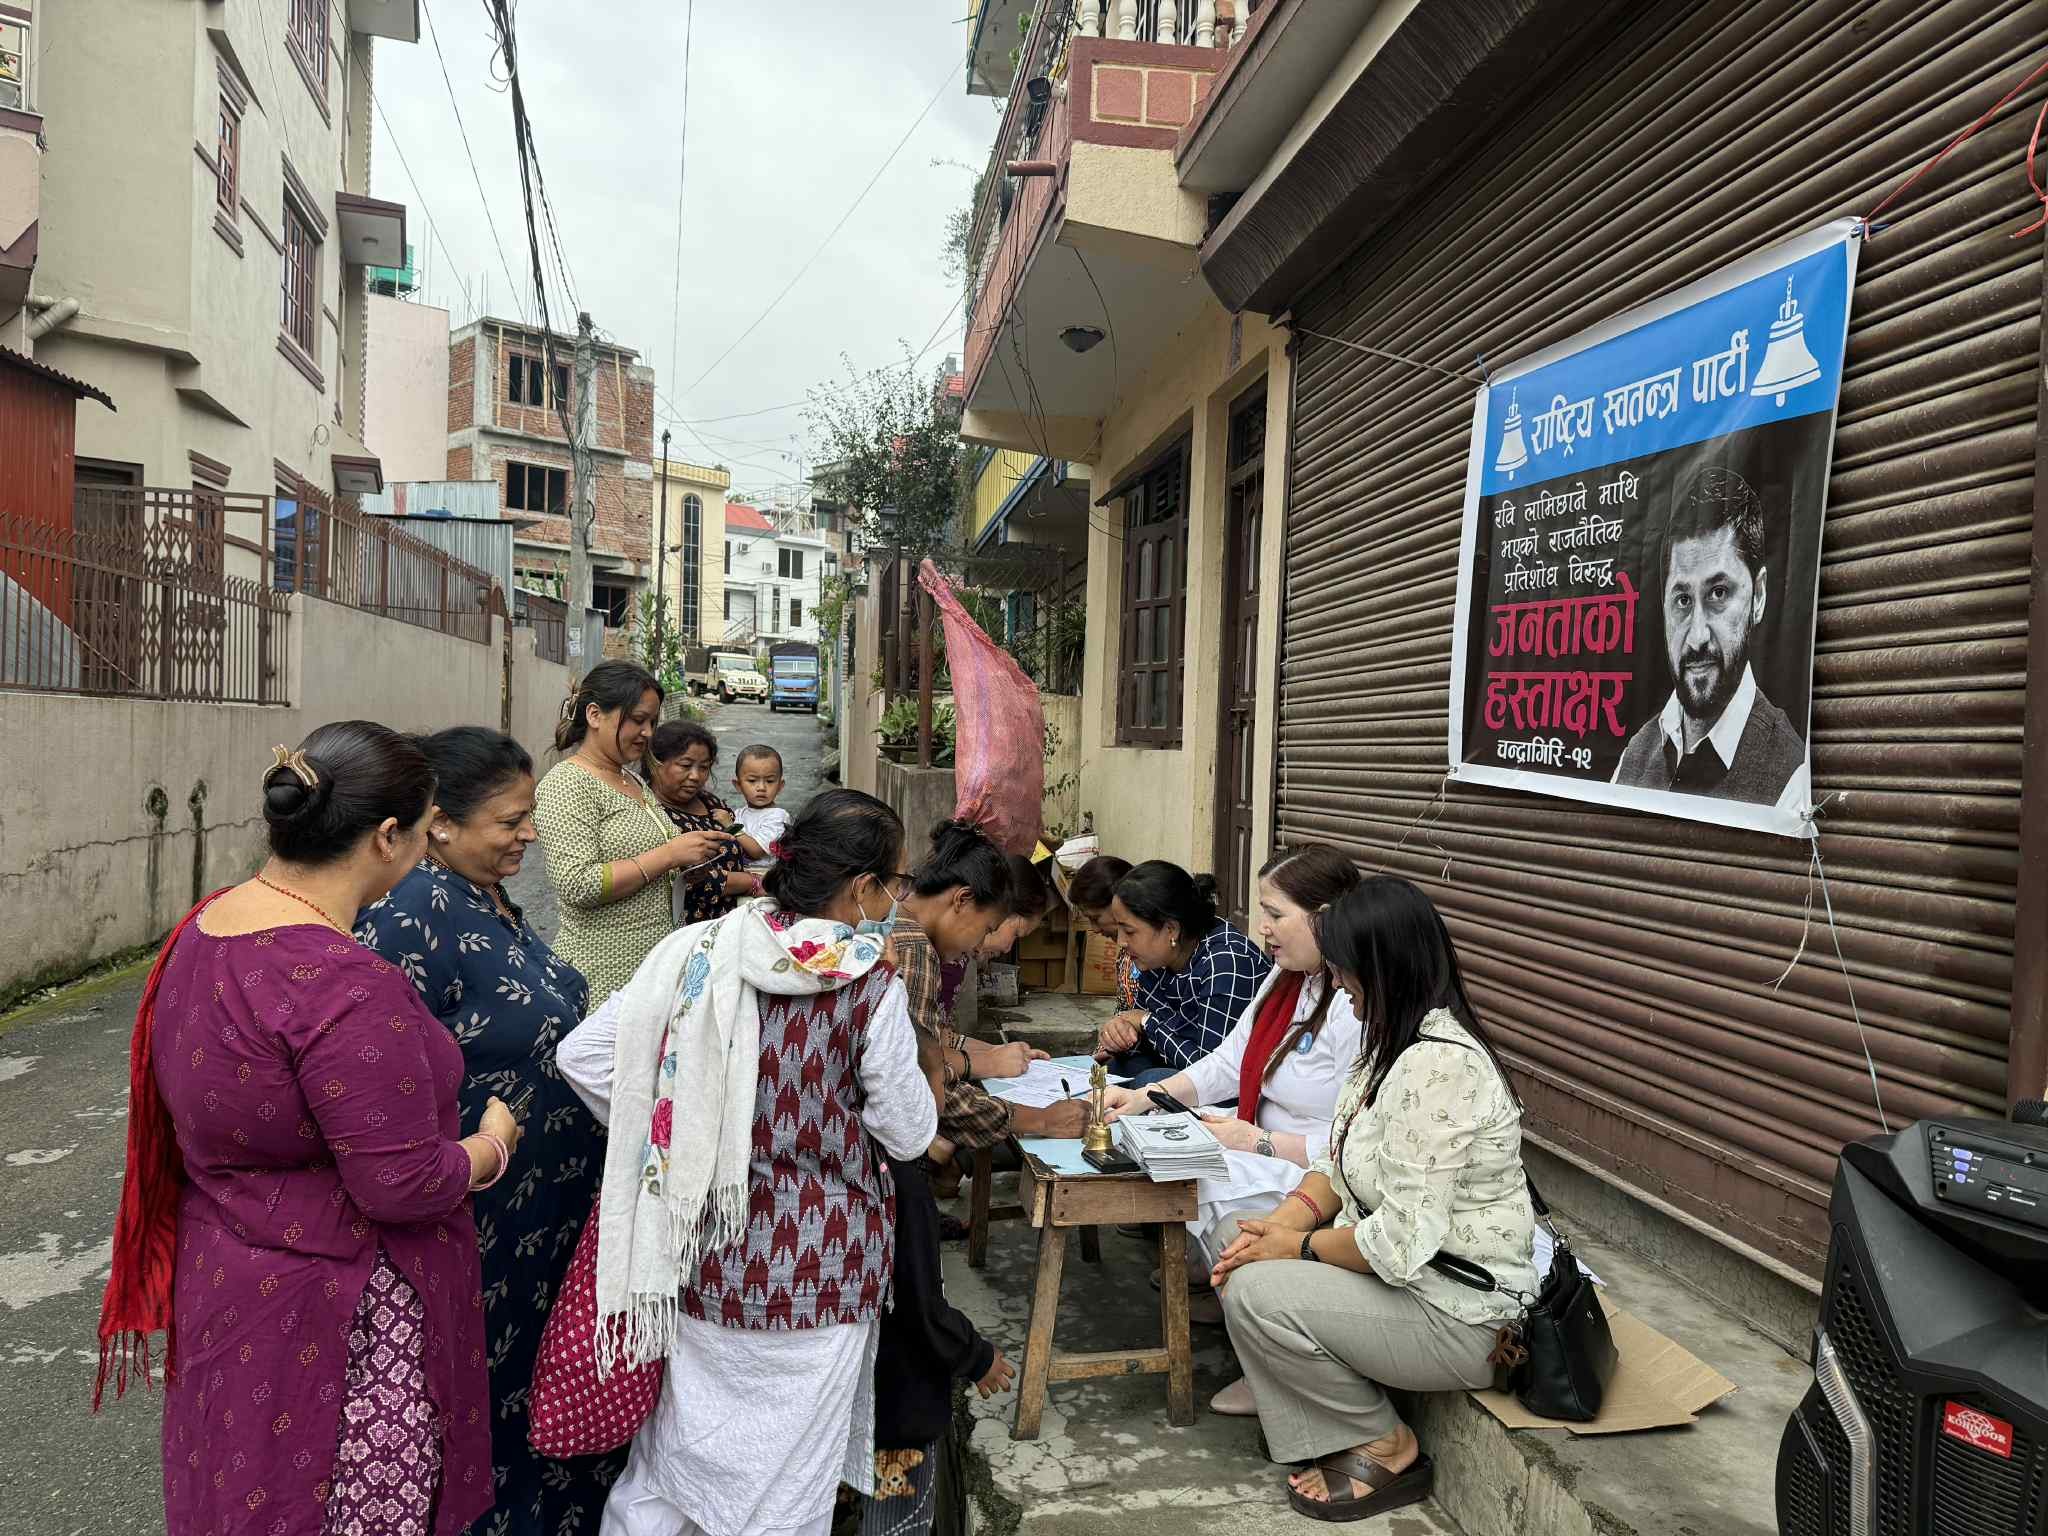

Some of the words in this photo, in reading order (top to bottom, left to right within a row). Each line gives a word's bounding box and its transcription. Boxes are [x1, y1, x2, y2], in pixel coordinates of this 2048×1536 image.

[1531, 394, 1595, 458] राष्ट्रिय
[1603, 367, 1682, 434] स्वतन्त्र
[1692, 328, 1750, 404] पार्टी
[1494, 500, 1516, 529] रवि
[1524, 481, 1588, 522] लामिछाने
[1599, 471, 1640, 505] माथि
[1501, 528, 1540, 563] भएको
[1548, 514, 1625, 552] राजनैतिक
[1504, 560, 1559, 594] प्रतिशोध
[1568, 555, 1615, 588] विरुद्ध
[1488, 571, 1640, 659] जनताको
[1484, 670, 1633, 738] हस्ताक्षर
[1947, 1414, 2007, 1444] KOHINOOR
